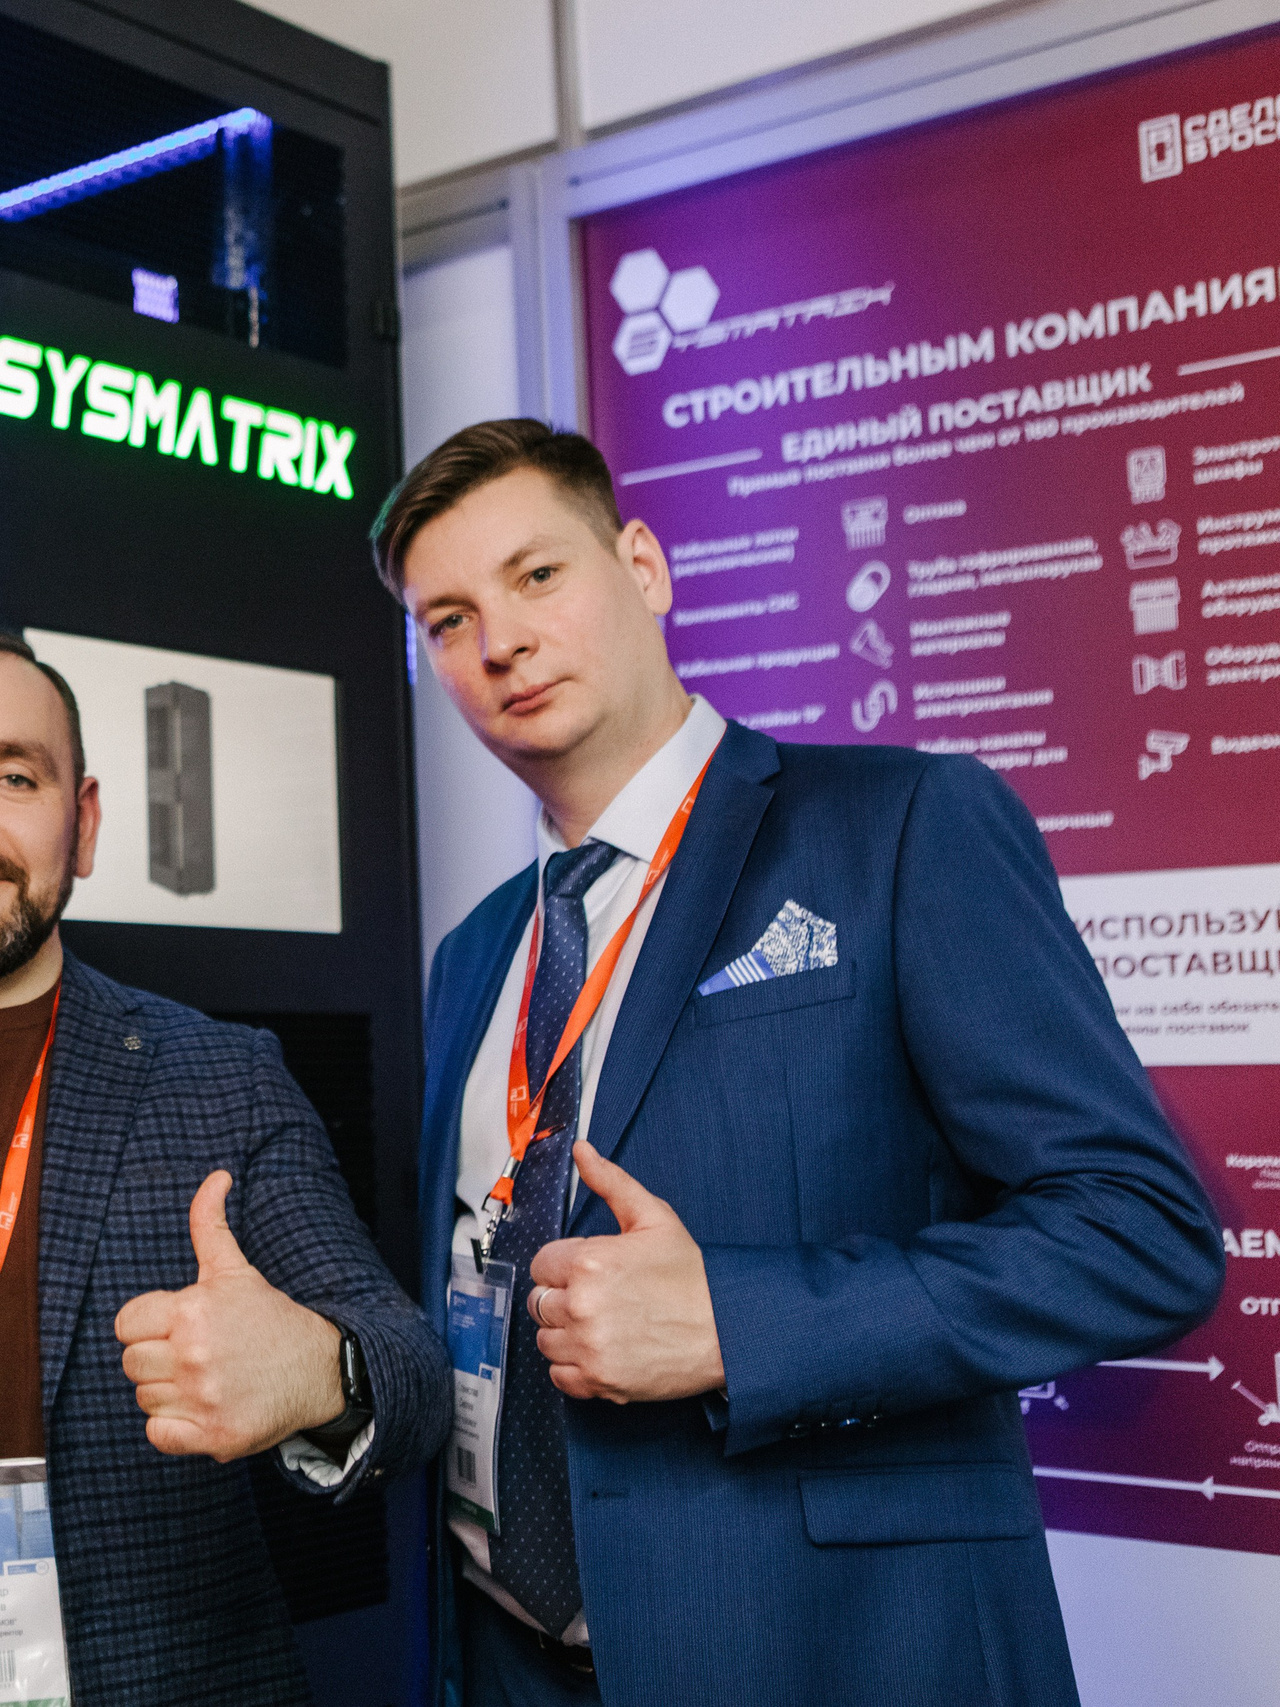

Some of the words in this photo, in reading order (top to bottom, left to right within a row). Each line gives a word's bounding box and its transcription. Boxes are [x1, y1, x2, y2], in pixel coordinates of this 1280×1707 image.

[1184, 94, 1280, 140] СДЕЛ
[1209, 120, 1280, 158] РОС
[662, 326, 995, 428] СТРОИТЕЛЬНЫМ
[1005, 264, 1280, 358] КОМПАНИЯ
[781, 403, 923, 463] ЕДИНЫЙ
[928, 361, 1152, 434] ПОСТАВЩИК
[1075, 907, 1280, 941] ИСПОЛЬЗУ
[1094, 949, 1280, 978] ПОСТАВЩ
